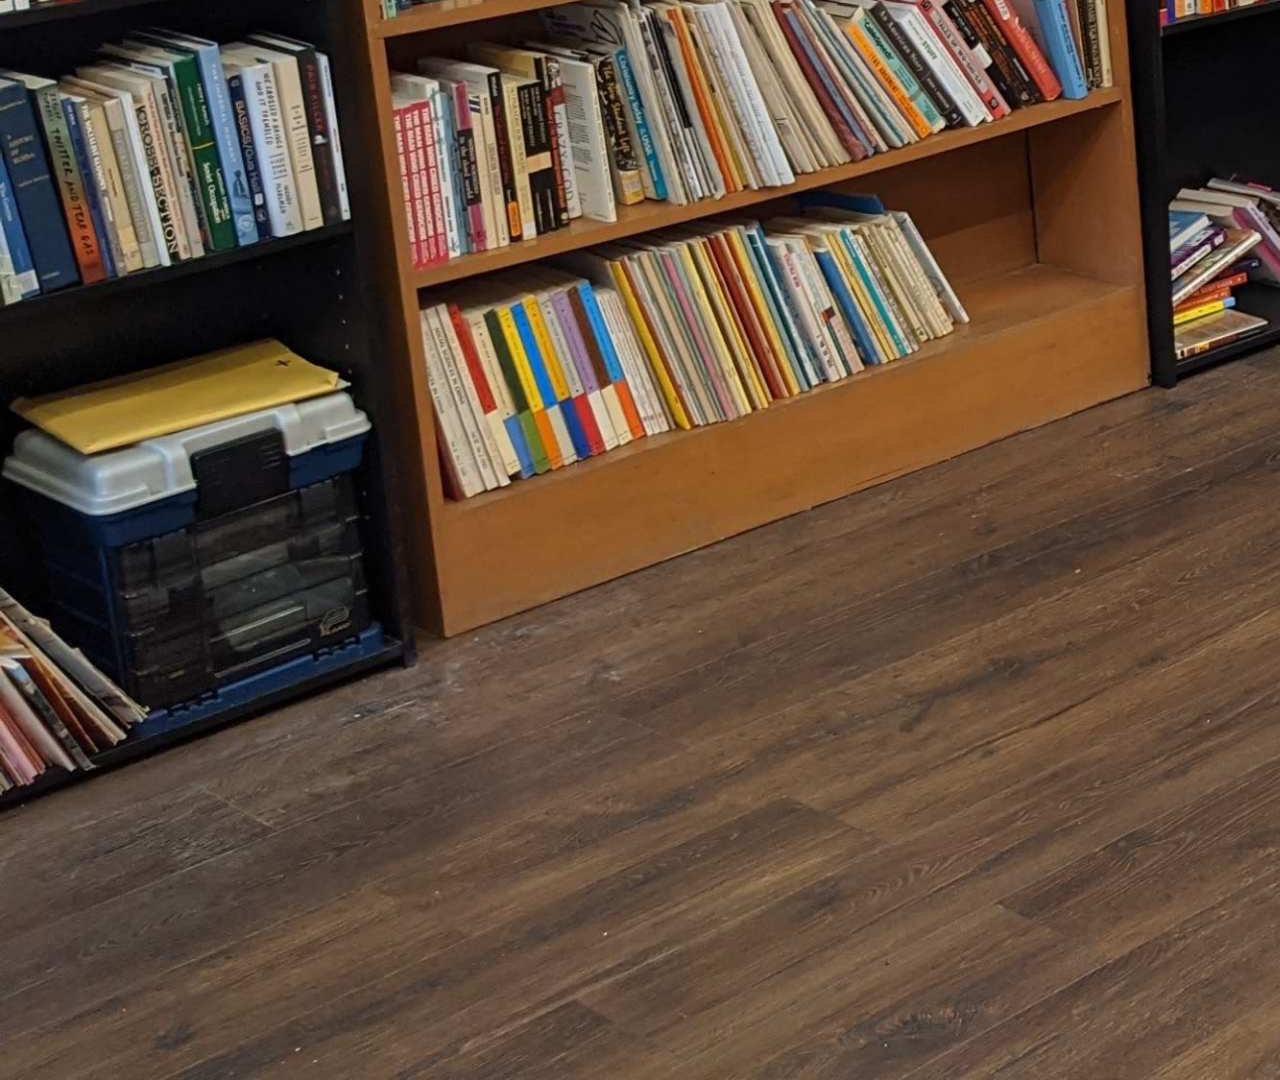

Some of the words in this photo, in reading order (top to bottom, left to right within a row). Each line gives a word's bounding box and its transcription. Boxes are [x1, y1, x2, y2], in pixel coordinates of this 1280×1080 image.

[50, 128, 74, 177] TWITTER
[64, 182, 79, 201] AND
[72, 205, 88, 230] TEAR
